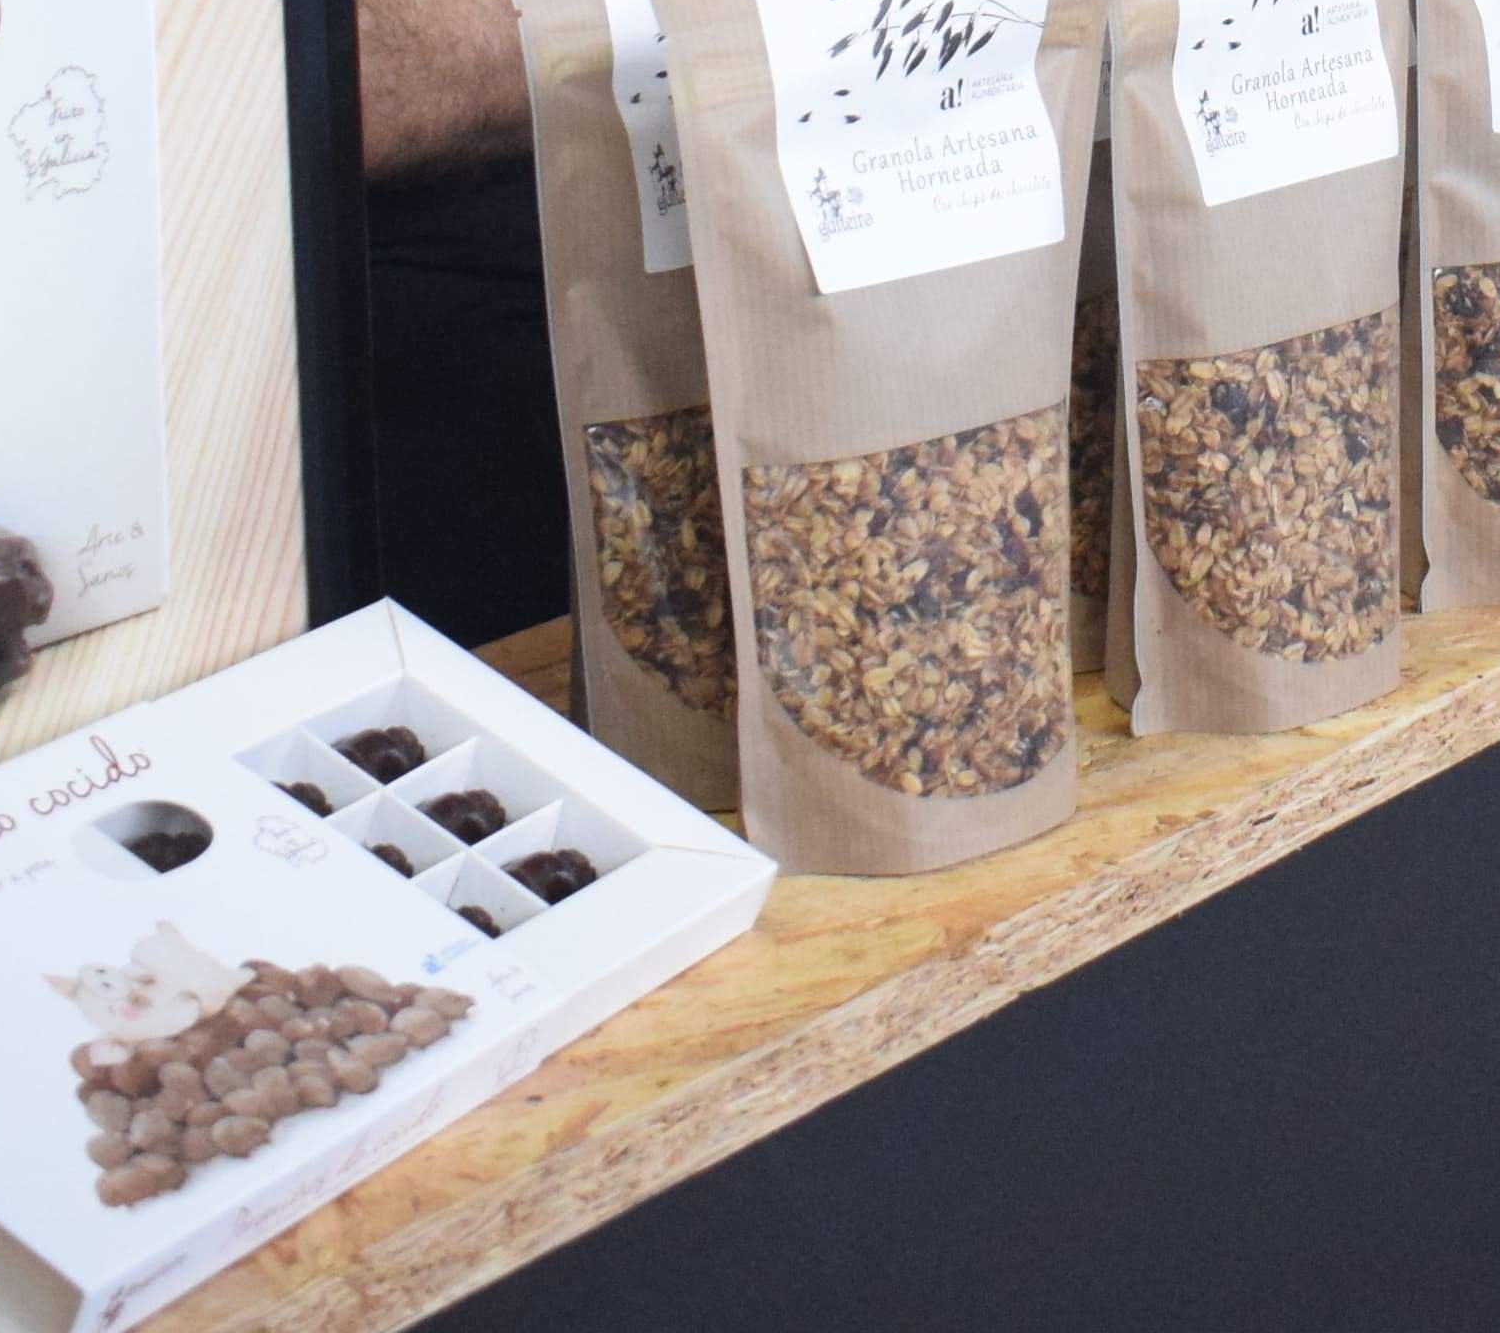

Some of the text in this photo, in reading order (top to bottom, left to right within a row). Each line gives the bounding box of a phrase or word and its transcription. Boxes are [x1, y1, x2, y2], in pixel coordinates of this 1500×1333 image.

[1302, 5, 1321, 36] a!
[1231, 47, 1374, 96] Granola Artesana
[1265, 73, 1349, 113] Horneada
[939, 77, 964, 111] a!
[852, 124, 1039, 174] Granola Artesana
[898, 151, 1004, 195] Horneada
[29, 735, 152, 816] cocido
